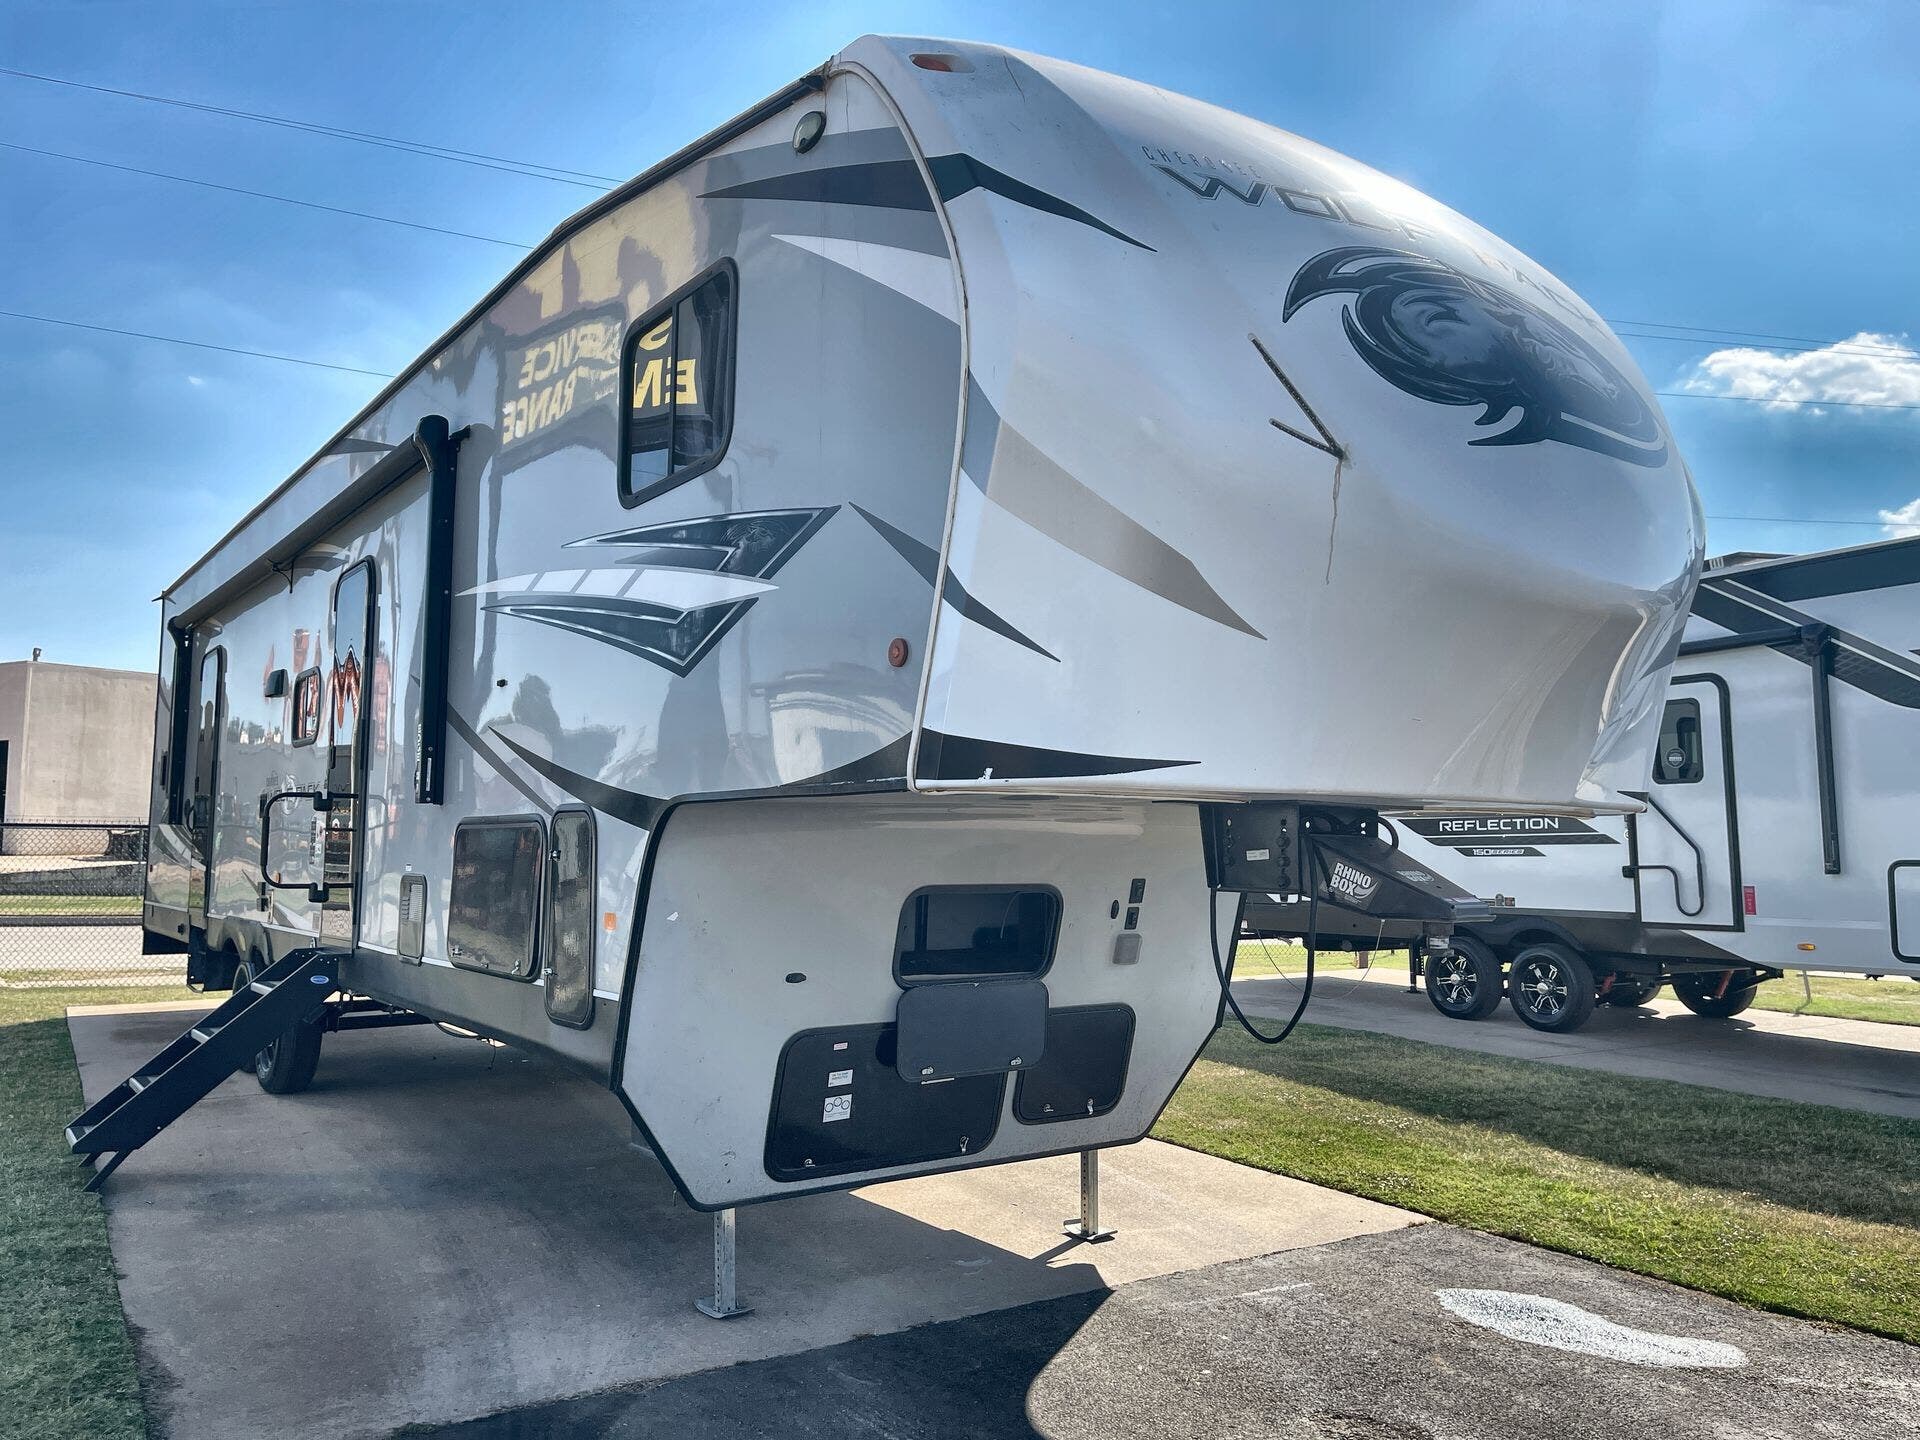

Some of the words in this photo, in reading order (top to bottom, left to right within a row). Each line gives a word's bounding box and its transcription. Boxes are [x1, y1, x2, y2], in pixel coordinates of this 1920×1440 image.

[1439, 817, 1559, 832] REFLECTION
[1330, 874, 1358, 896] BOX
[1334, 862, 1372, 889] RHINO
